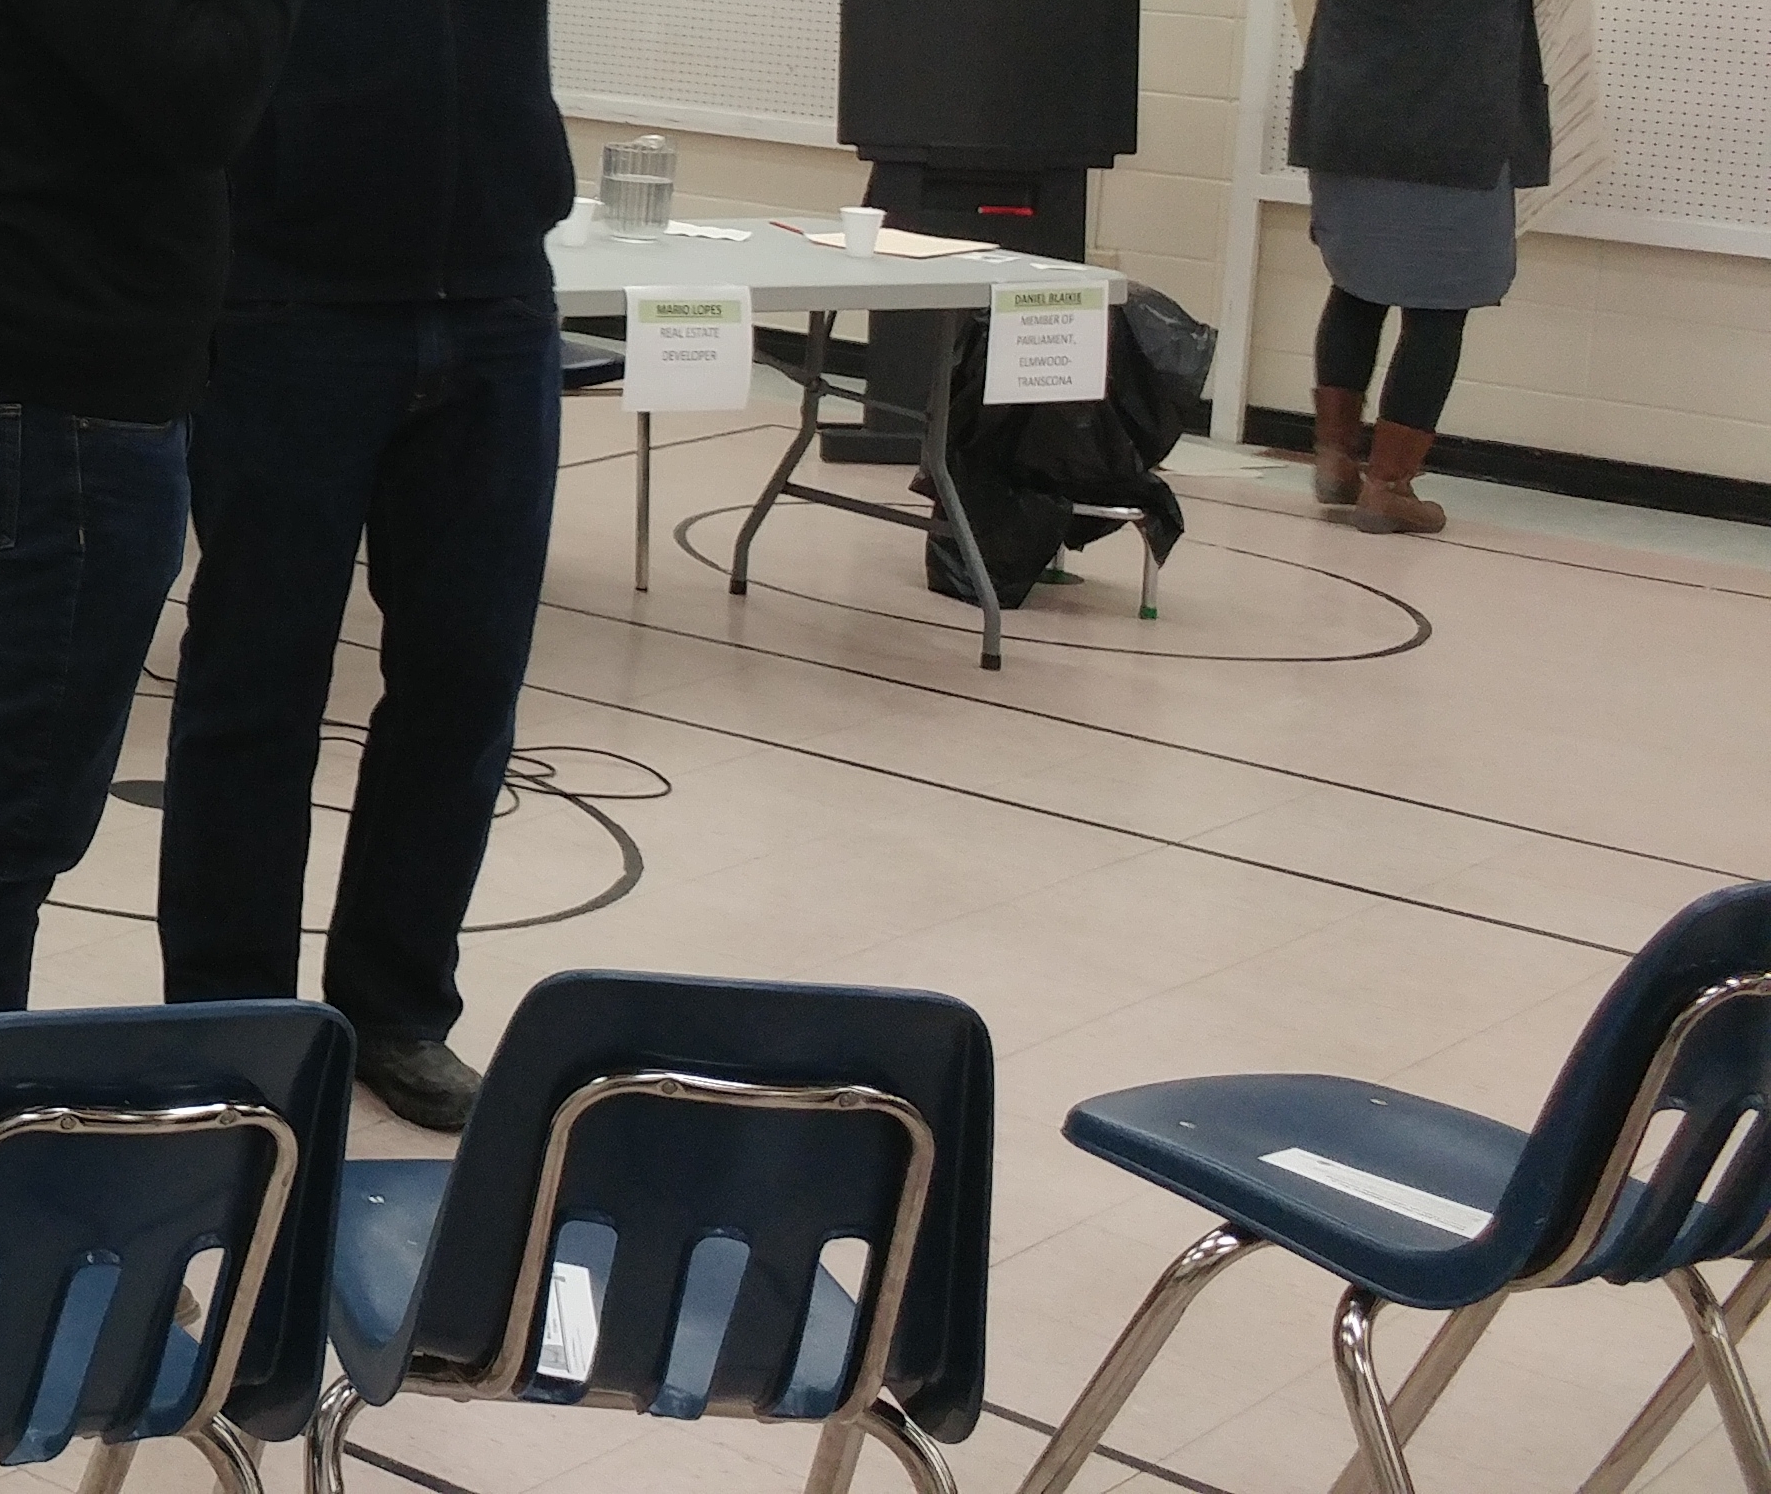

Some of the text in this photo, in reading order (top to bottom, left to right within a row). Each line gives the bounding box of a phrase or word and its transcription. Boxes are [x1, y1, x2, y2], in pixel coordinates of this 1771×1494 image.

[1015, 293, 1046, 305] DANIEL
[692, 304, 722, 315] LOPES
[1021, 314, 1075, 326] MEMBER OF
[660, 327, 721, 338] REAL ESTATE
[662, 350, 717, 361] DEVELOPER
[1019, 355, 1073, 367] ELMWOOD-
[1018, 376, 1073, 387] TRANSCONA
